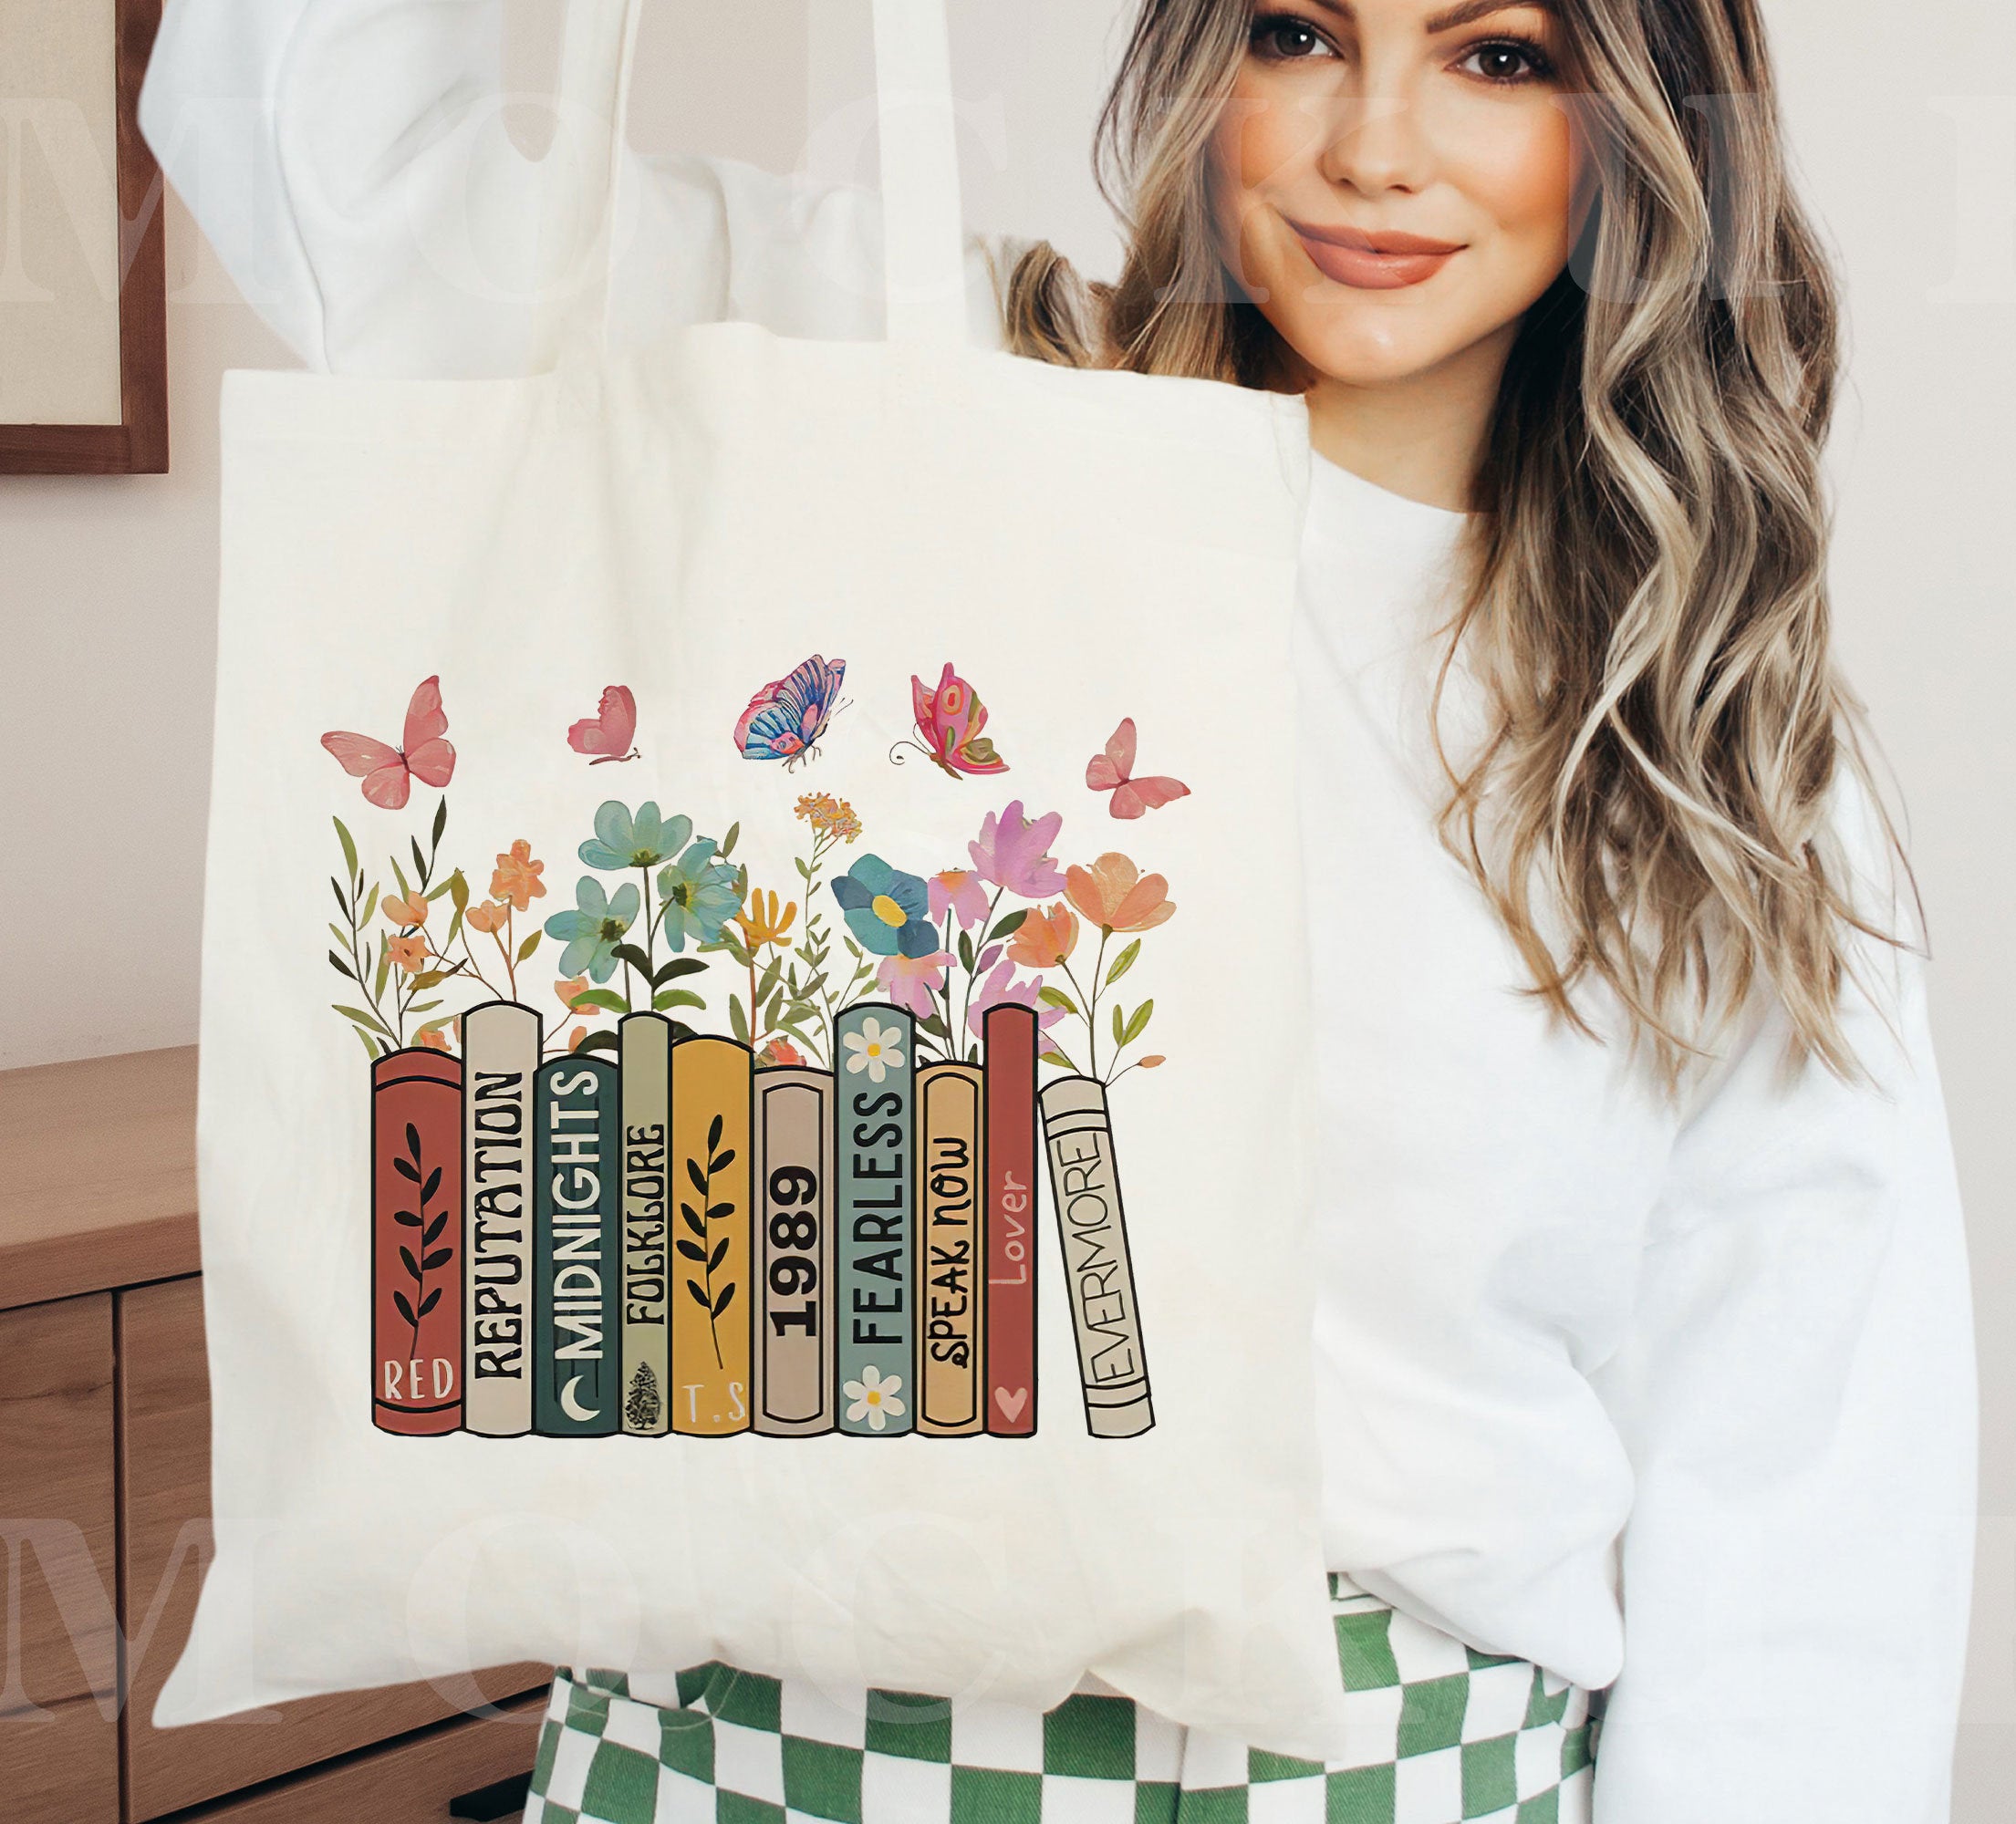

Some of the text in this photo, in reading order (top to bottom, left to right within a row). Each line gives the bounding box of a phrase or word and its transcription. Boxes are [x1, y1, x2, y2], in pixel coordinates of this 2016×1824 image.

[473, 1071, 524, 1380] REPUTATION
[550, 1070, 604, 1360] MIDNIGHTS
[626, 1123, 665, 1325] FOLKLORE
[769, 1165, 817, 1338] 1989
[852, 1092, 903, 1344] FEARLESS
[927, 1239, 970, 1369] SPEAK
[988, 1170, 1027, 1286] Lover
[1055, 1131, 1136, 1384] EVERMORE
[383, 1357, 454, 1400] RED
[682, 1382, 746, 1424] T.S
